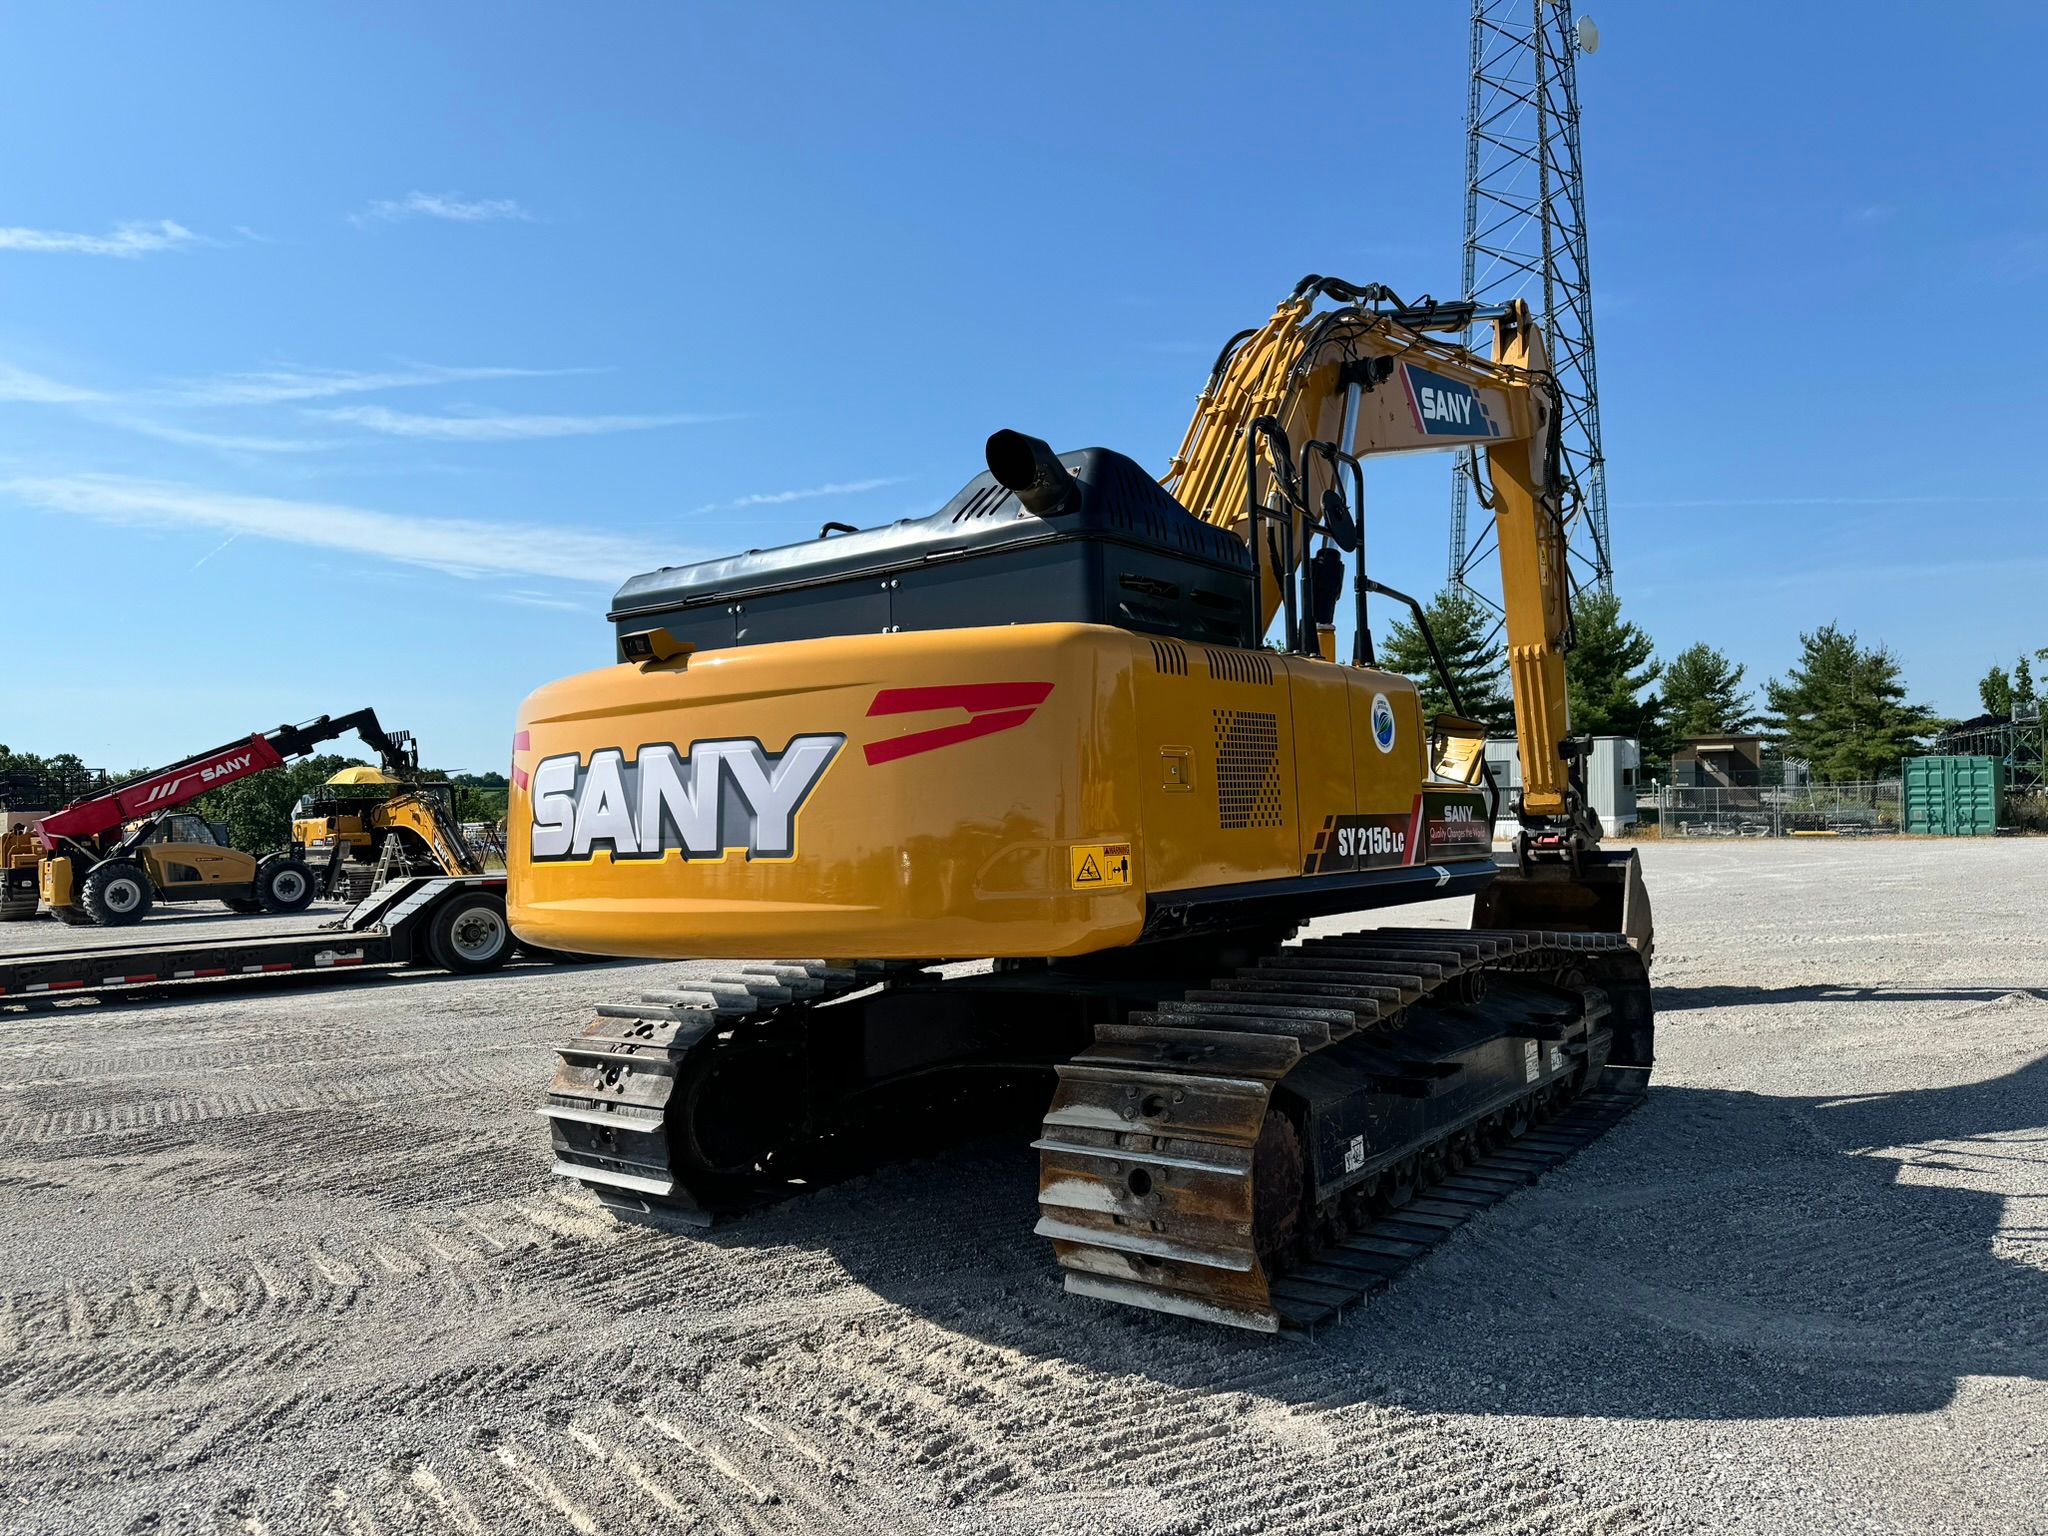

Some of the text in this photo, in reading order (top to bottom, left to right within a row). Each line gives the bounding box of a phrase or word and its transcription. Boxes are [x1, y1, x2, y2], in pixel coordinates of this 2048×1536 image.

[1421, 386, 1472, 425] SANY
[200, 753, 252, 782] SANY
[532, 734, 845, 862] SANY
[1444, 805, 1474, 823] SANY
[1429, 826, 1447, 841] Quality
[1447, 826, 1465, 841] Changes
[1465, 826, 1473, 838] the
